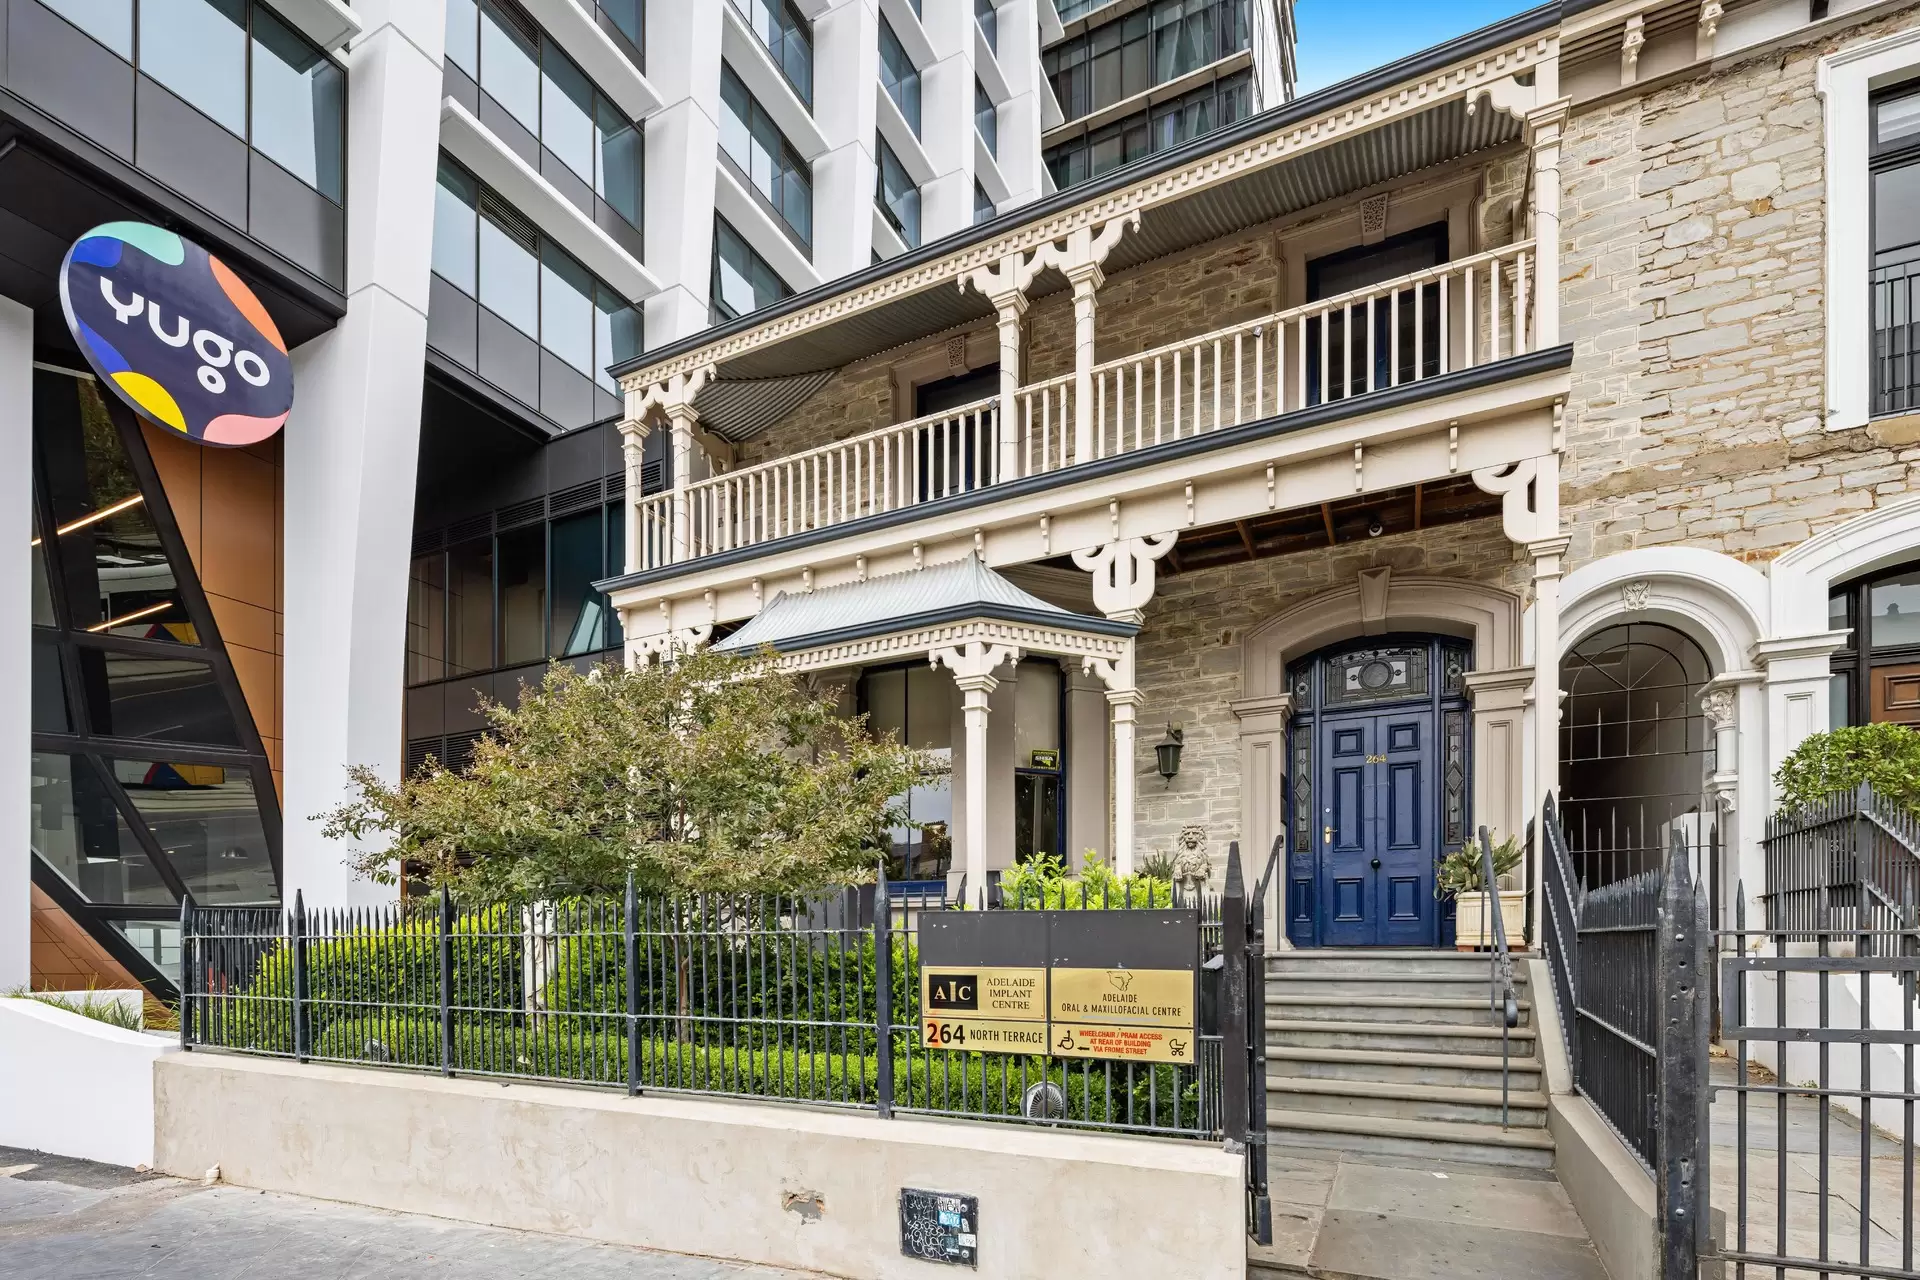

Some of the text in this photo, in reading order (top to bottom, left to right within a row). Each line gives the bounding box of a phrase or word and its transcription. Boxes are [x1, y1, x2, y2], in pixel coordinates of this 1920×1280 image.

[1366, 754, 1386, 763] 264
[986, 978, 1036, 987] ADELAIDE
[989, 989, 1032, 999] IMPLANT
[1102, 993, 1138, 1003] ADELAIDE
[992, 1000, 1030, 1010] CENTRE
[1061, 1003, 1181, 1017] ORAL & MAXILLOFACIAL CENTRE
[927, 1023, 1043, 1045] 264 NORTH TERRACE
[1079, 1030, 1116, 1039] WHEELCHAIR
[1139, 1032, 1163, 1041] ACCESS
[1098, 1038, 1114, 1046] REAR
[1124, 1040, 1151, 1048] BUILDING
[1093, 1045, 1147, 1055] VIA FROME STREET
